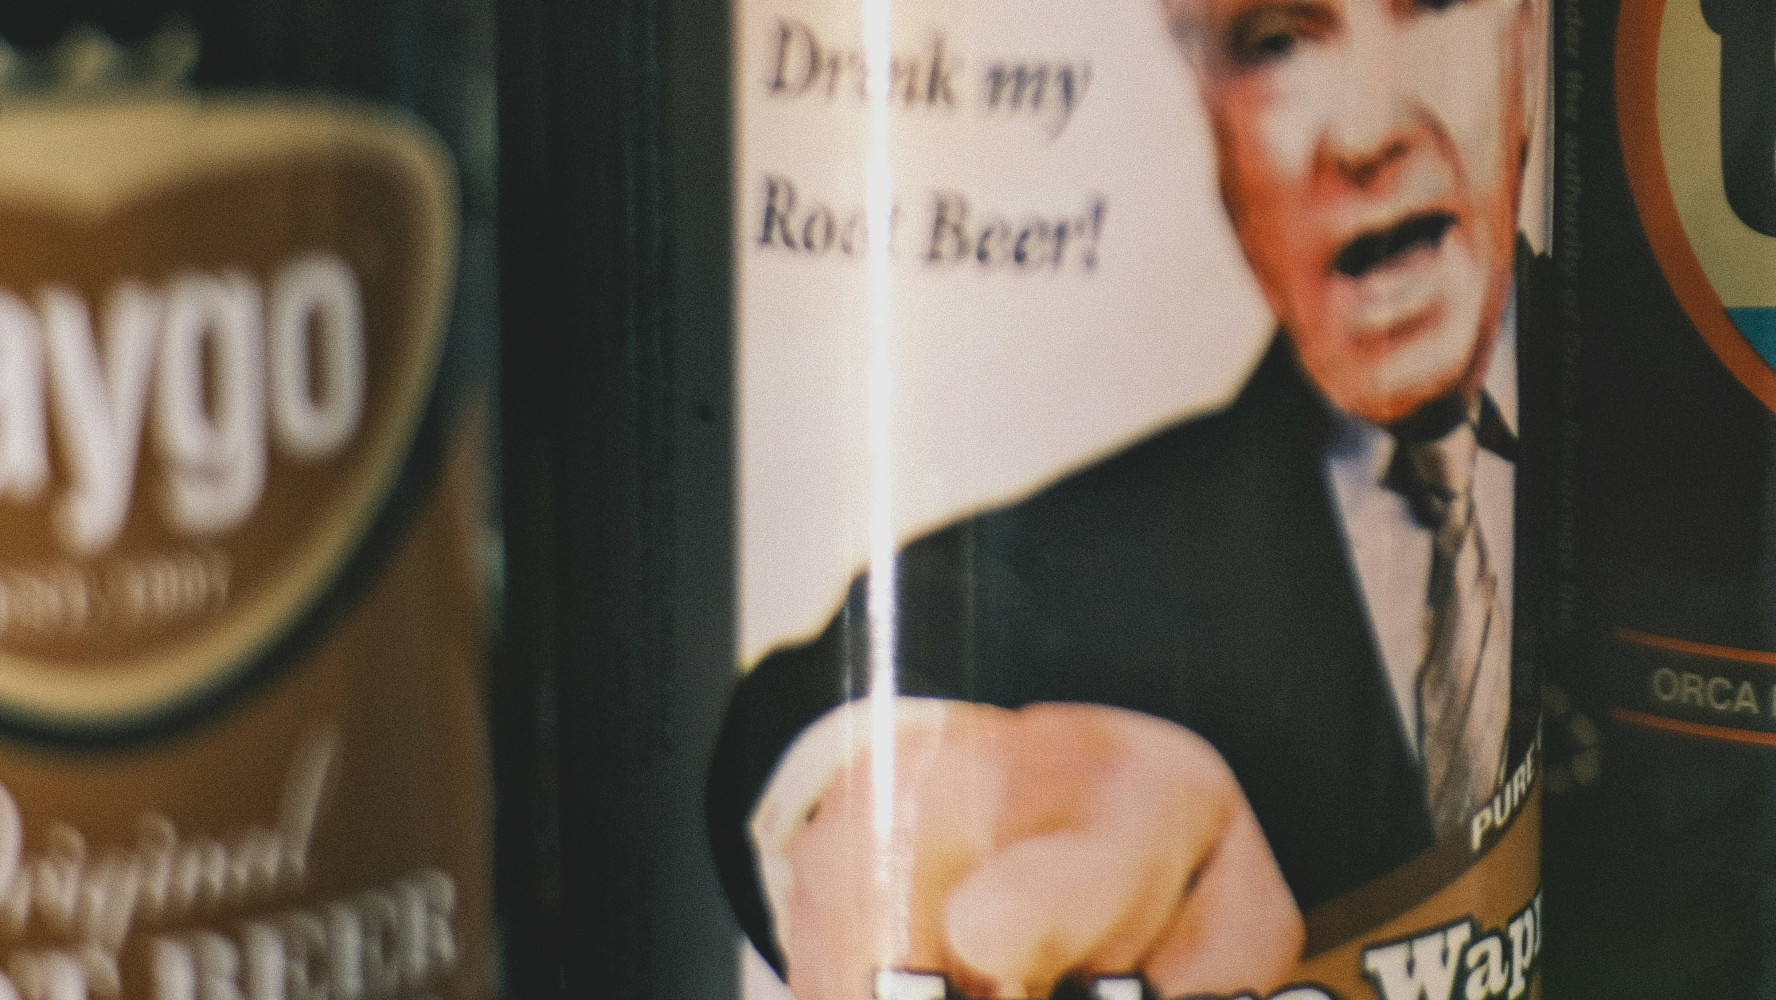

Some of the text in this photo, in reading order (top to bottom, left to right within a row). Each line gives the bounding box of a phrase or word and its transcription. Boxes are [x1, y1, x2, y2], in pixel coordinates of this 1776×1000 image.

[765, 16, 1094, 142] Drnk my
[1563, 70, 1583, 122] the
[756, 172, 1108, 273] Roo Beer!
[1560, 131, 1582, 278] authority
[1651, 666, 1759, 715] ORCA
[1362, 888, 1542, 1000] Wap
